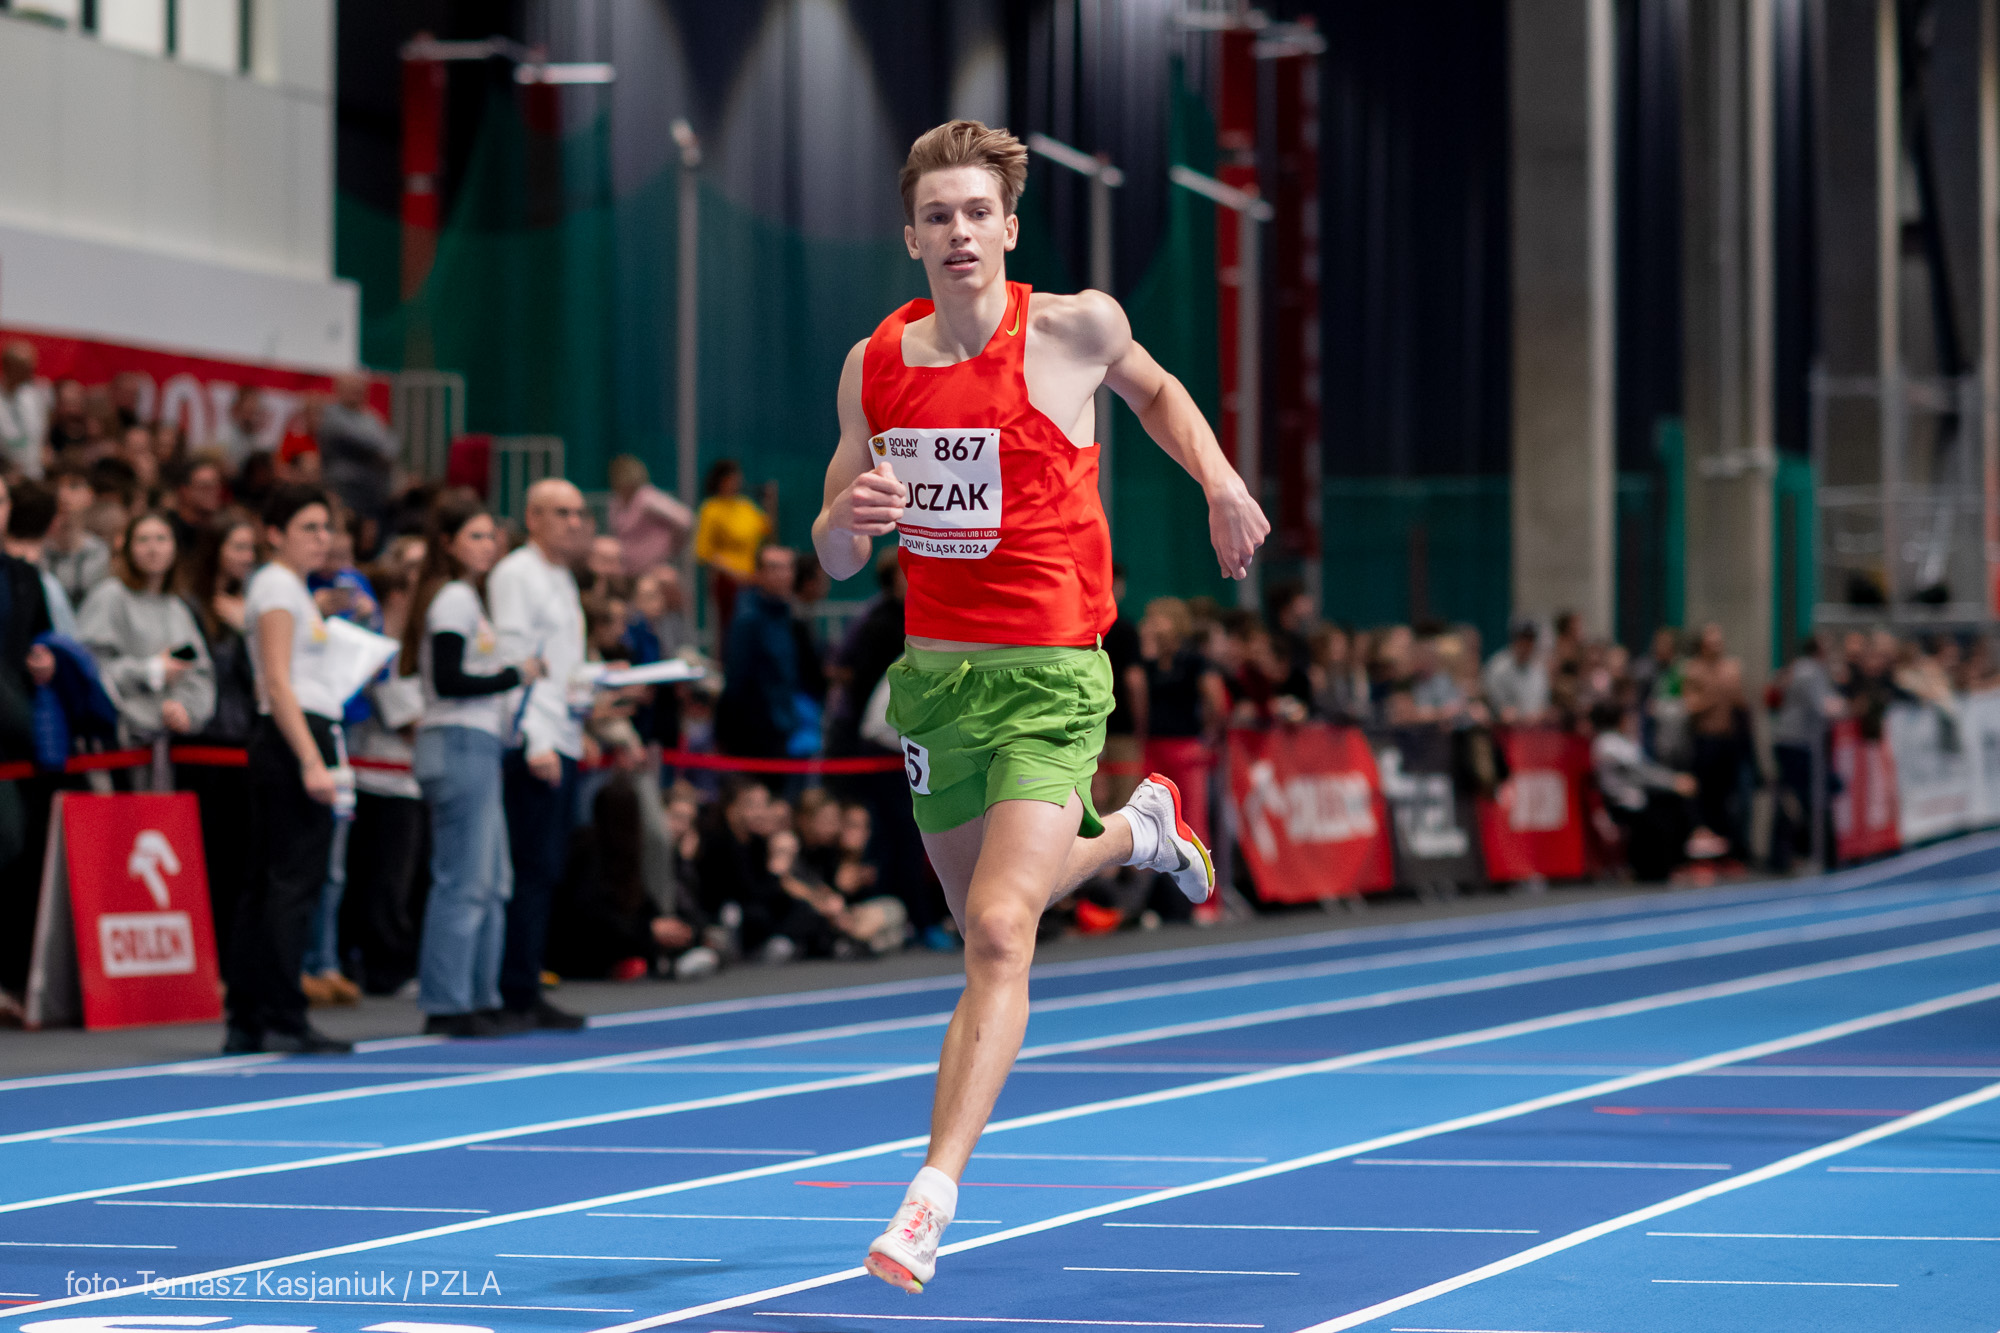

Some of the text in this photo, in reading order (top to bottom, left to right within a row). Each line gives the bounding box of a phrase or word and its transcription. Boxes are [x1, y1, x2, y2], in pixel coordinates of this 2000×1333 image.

[889, 437, 919, 447] DOLNY
[934, 437, 986, 461] 867
[890, 447, 918, 458] ŚLĄSK
[899, 481, 989, 511] UCZAK
[948, 530, 966, 538] Polski
[967, 530, 979, 538] U18
[926, 540, 957, 555] ŚLĄSK
[958, 544, 988, 554] 2024
[907, 743, 922, 787] 5
